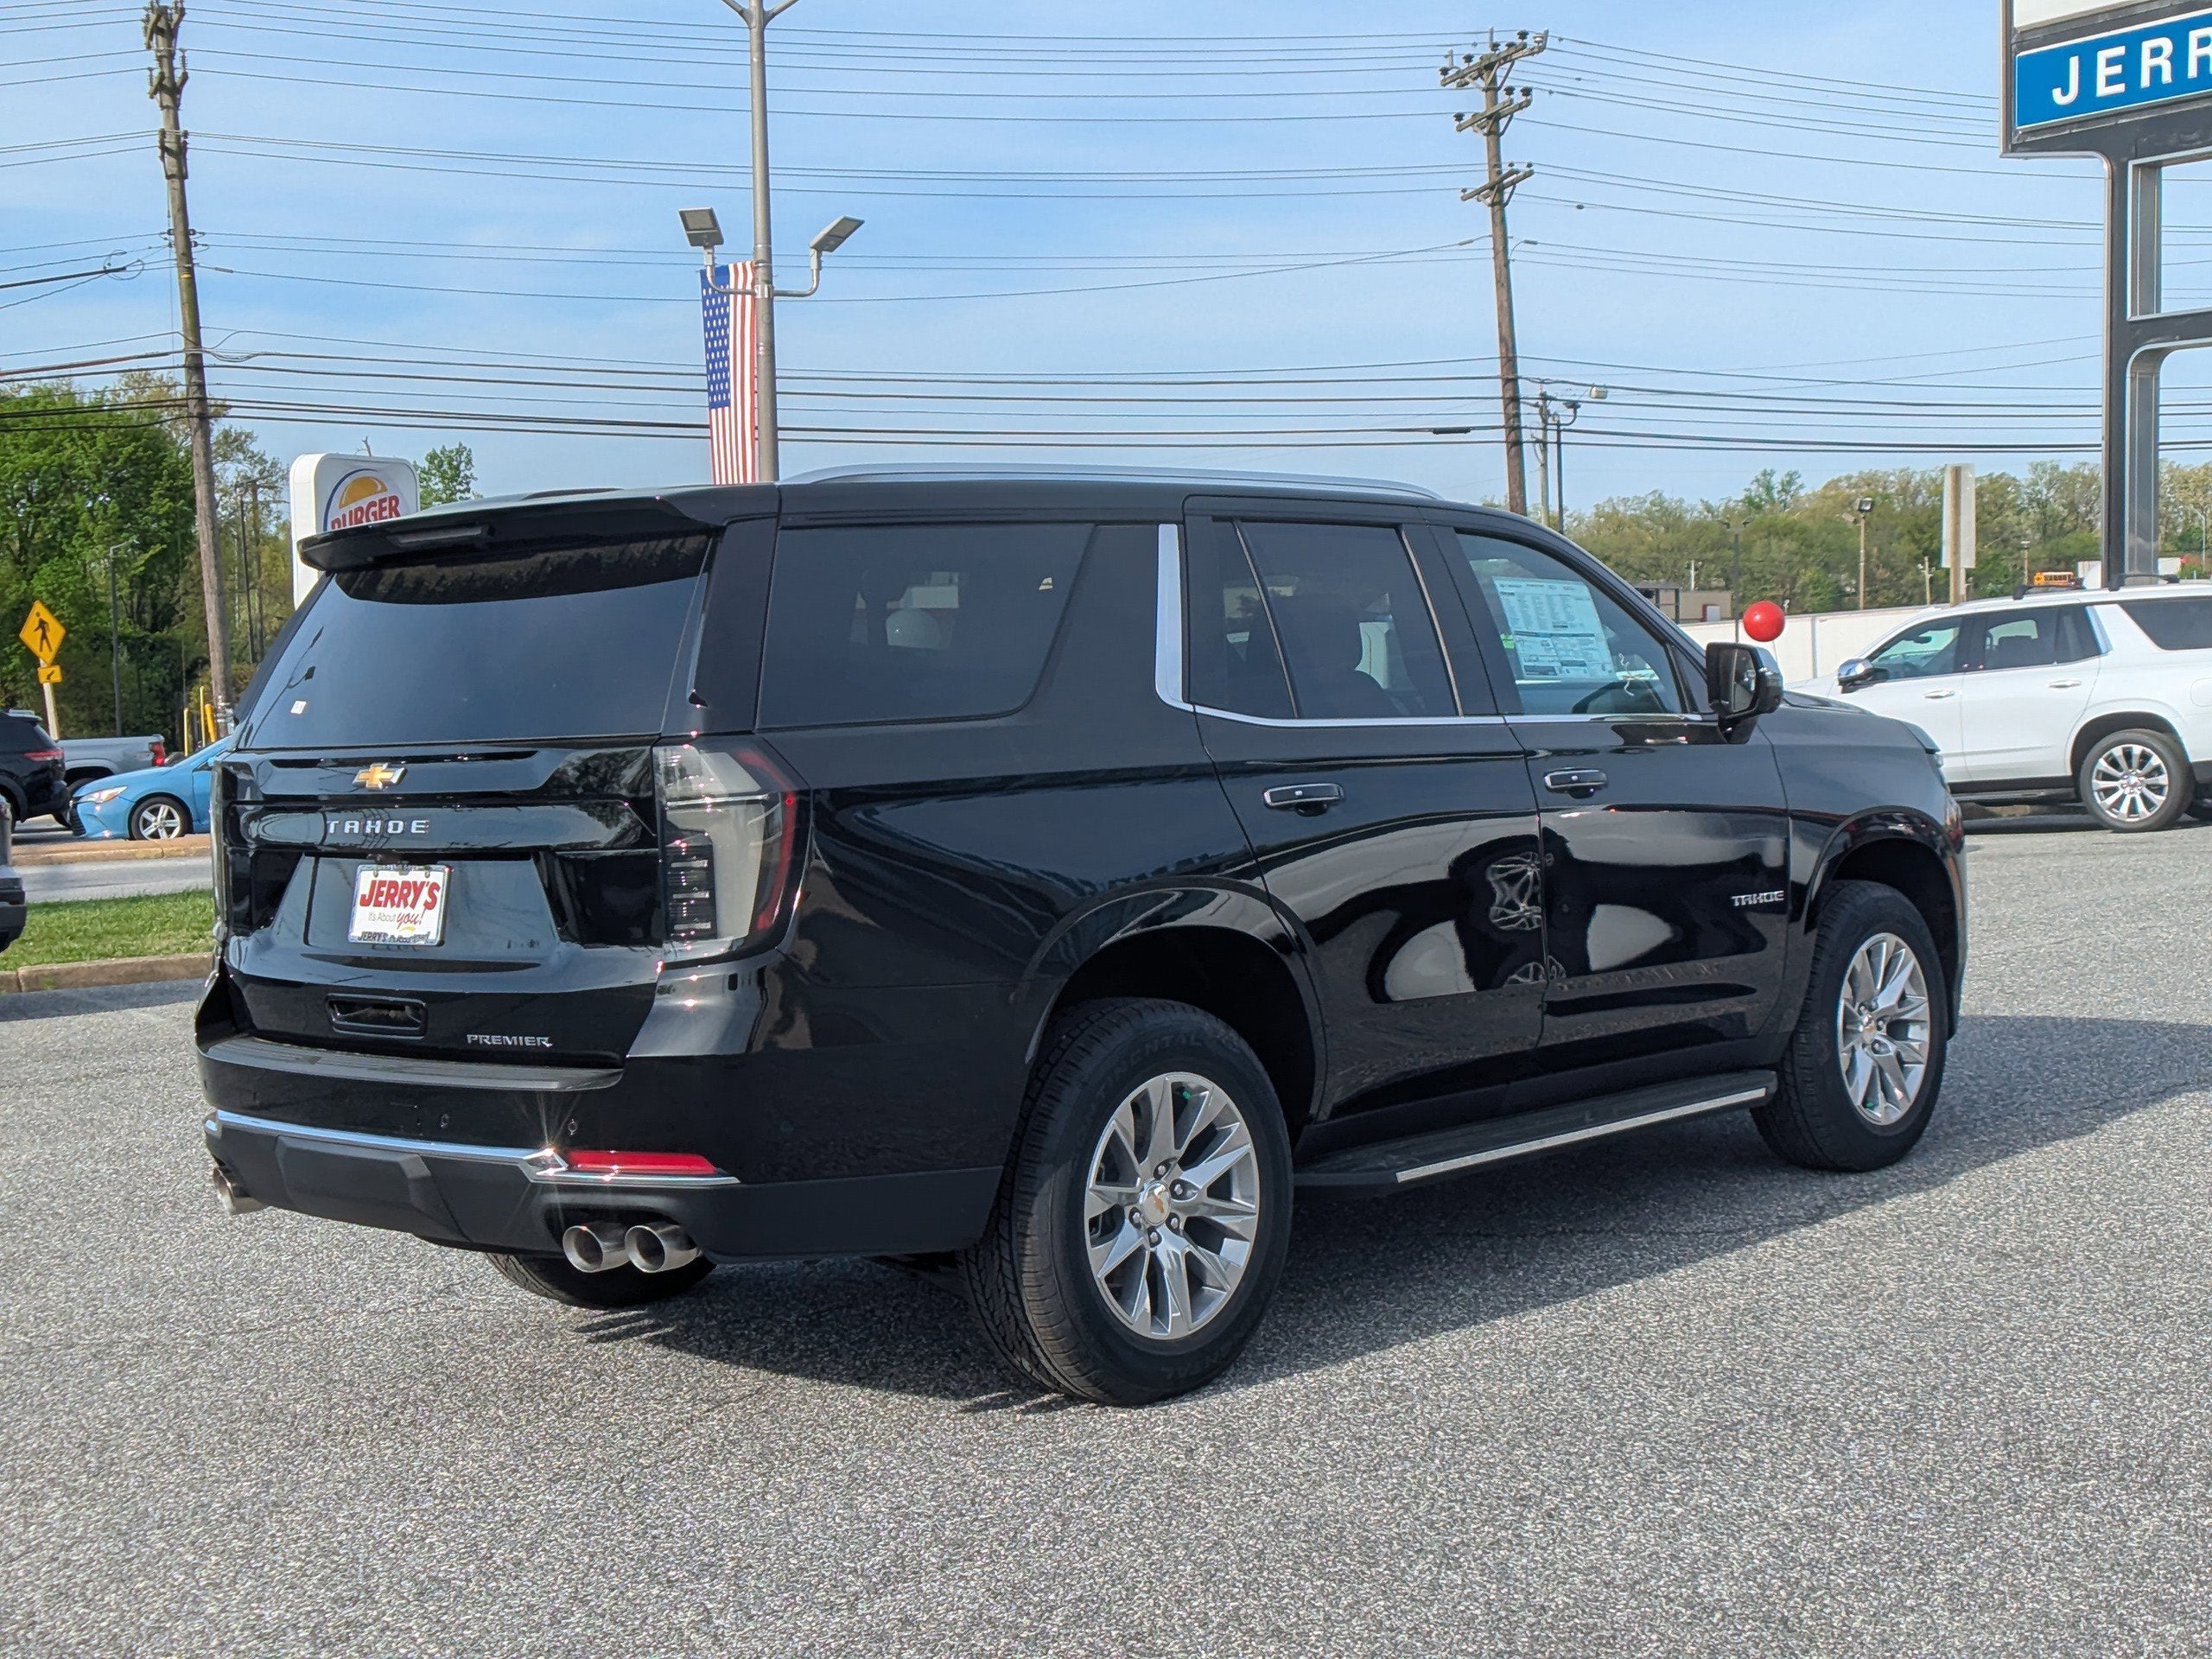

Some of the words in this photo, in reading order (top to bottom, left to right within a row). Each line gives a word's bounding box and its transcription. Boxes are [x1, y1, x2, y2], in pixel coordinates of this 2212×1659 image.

[2051, 26, 2212, 105] JERR
[327, 820, 429, 834] TAHOE
[359, 880, 441, 911] JERRY'S
[1731, 890, 1784, 906] TAHOE
[377, 912, 397, 922] About
[467, 1034, 553, 1047] PREMIER
